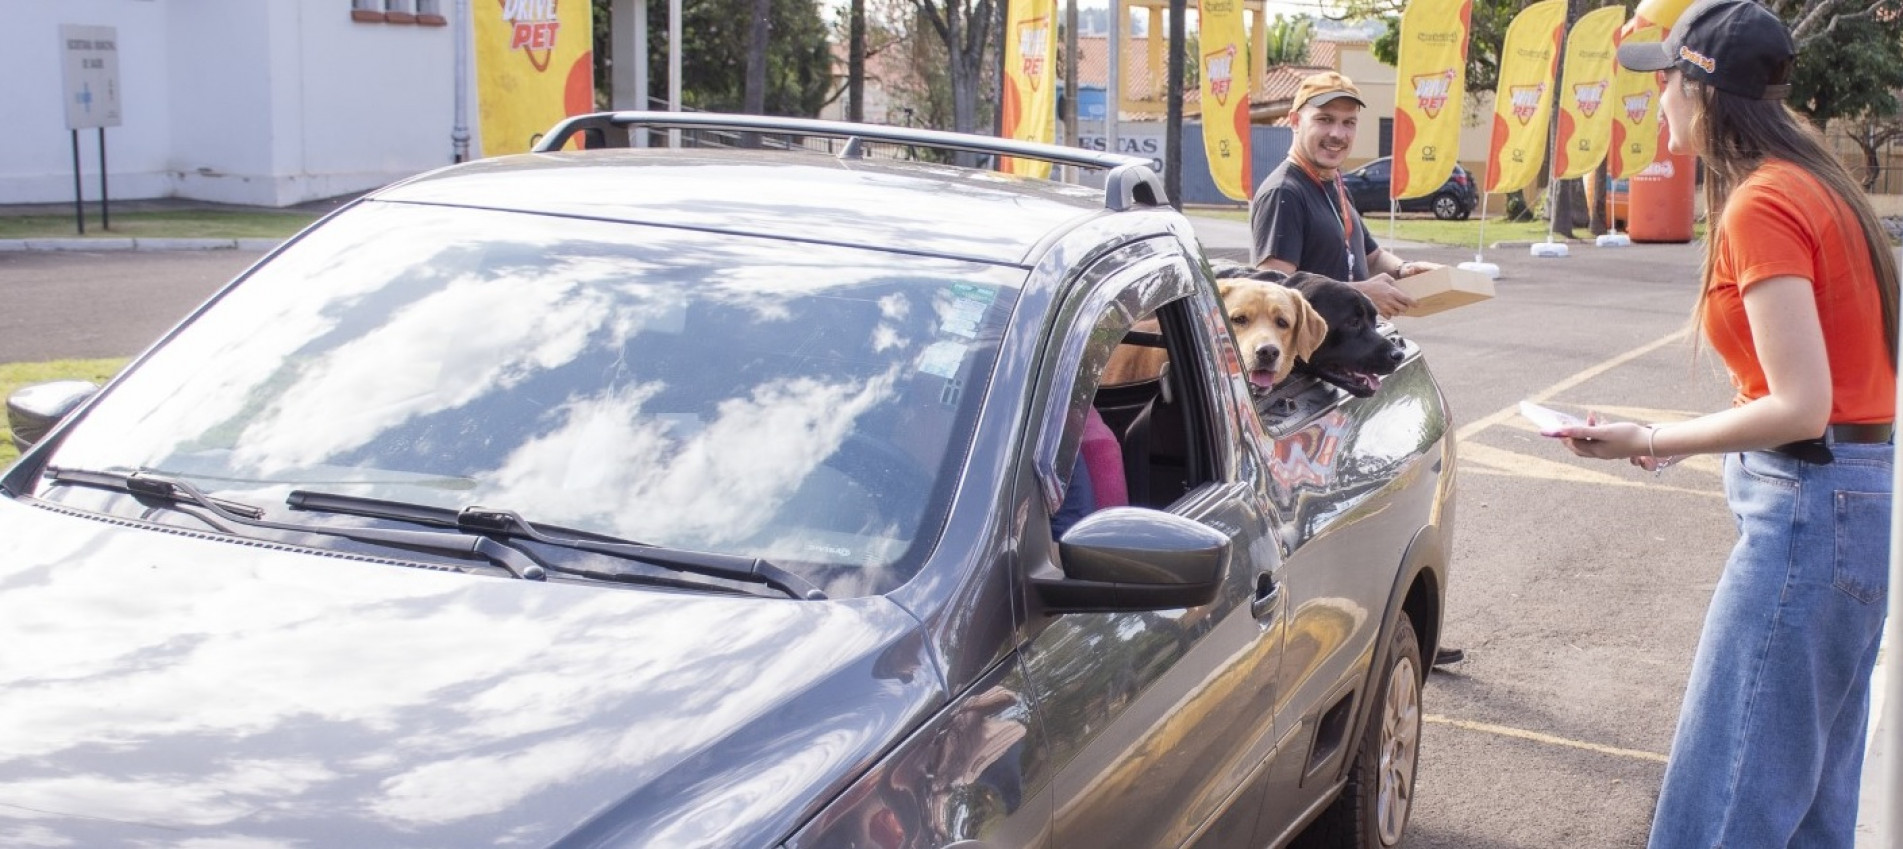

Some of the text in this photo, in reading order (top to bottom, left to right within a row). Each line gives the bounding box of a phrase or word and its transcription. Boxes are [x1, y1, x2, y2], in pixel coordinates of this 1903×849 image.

[510, 22, 561, 51] PET
[1211, 79, 1232, 94] PET
[1417, 96, 1448, 109] PET
[1078, 137, 1158, 153] ESTAS
